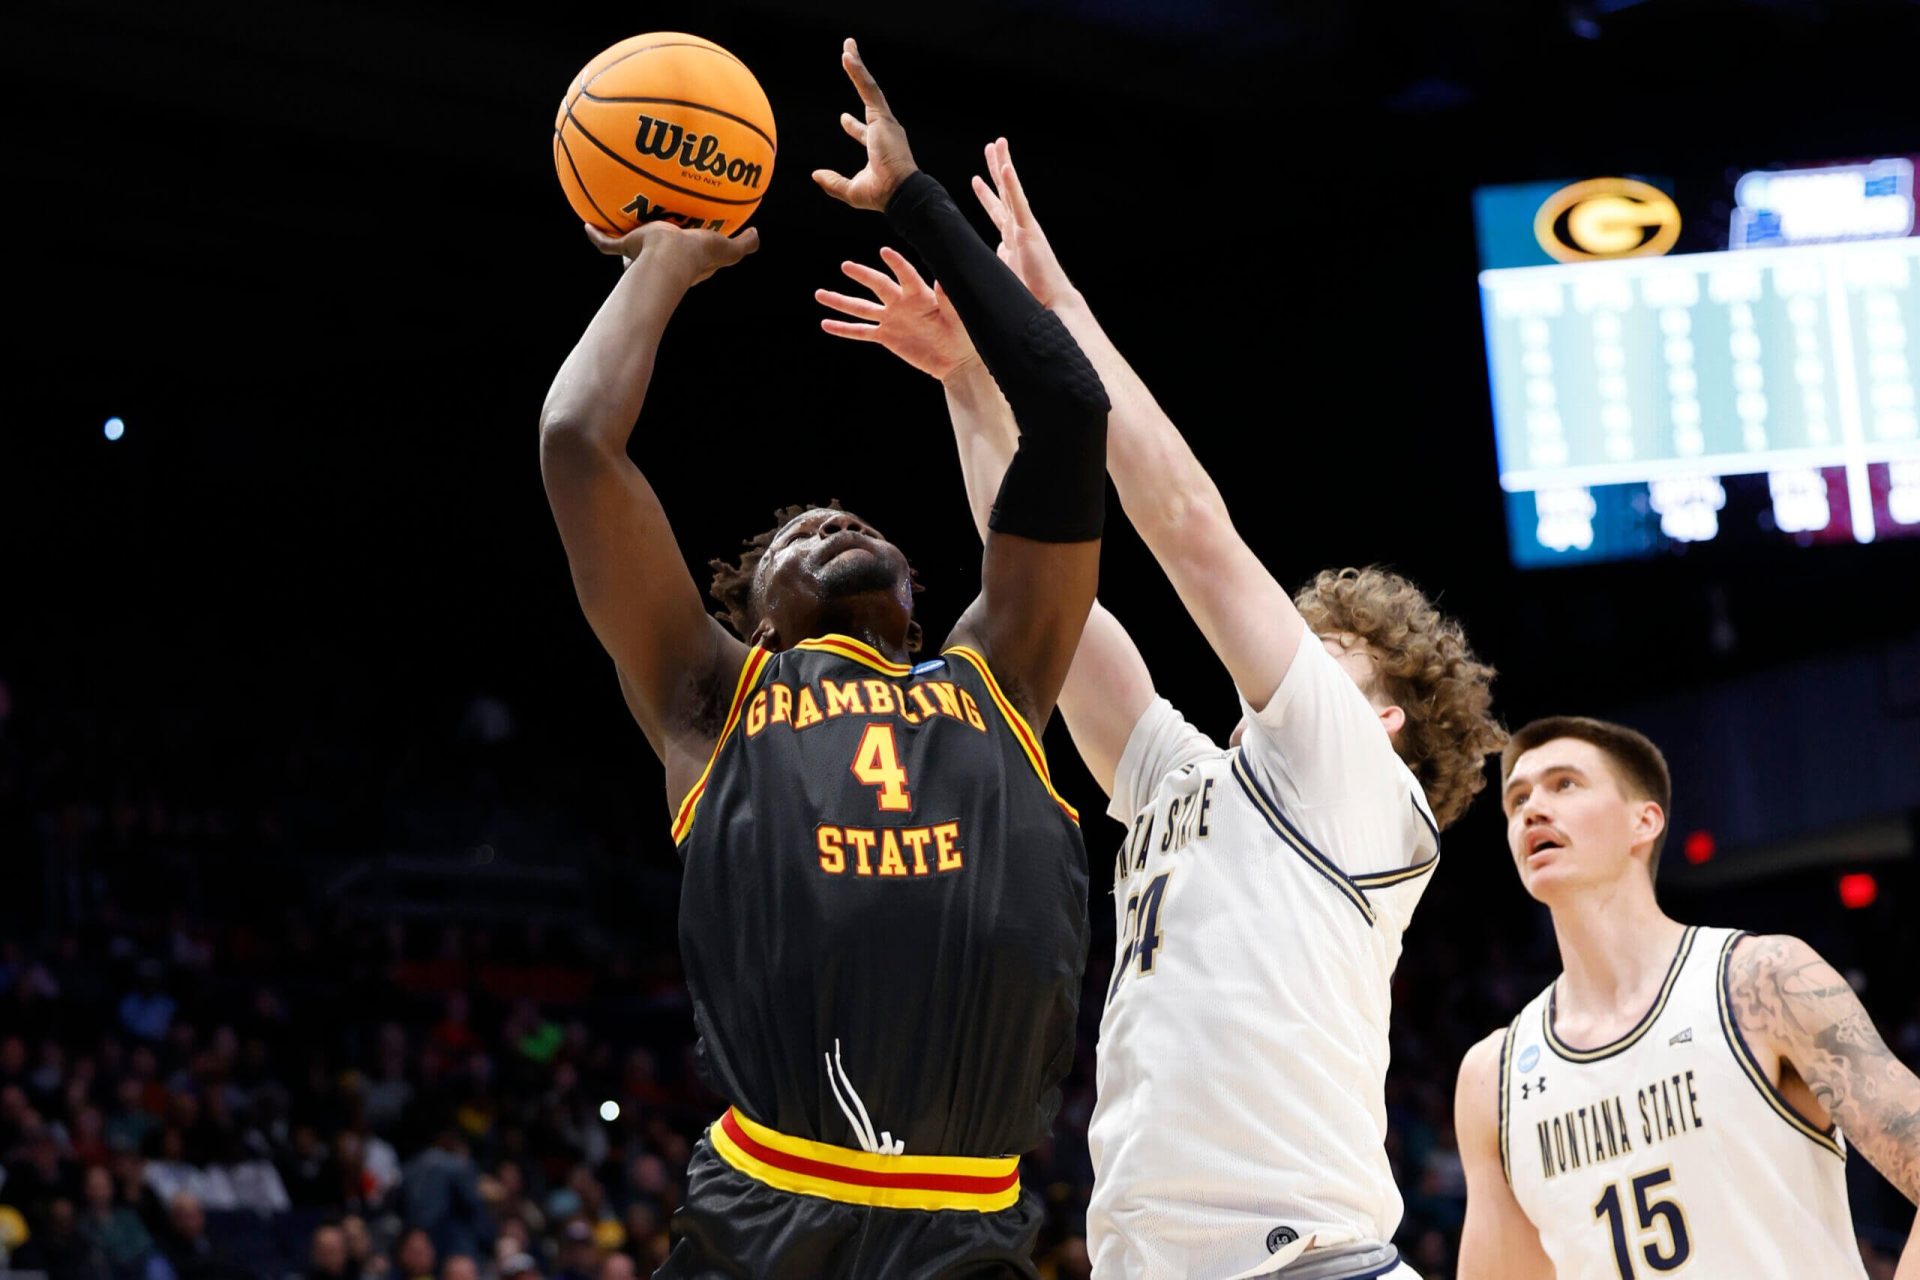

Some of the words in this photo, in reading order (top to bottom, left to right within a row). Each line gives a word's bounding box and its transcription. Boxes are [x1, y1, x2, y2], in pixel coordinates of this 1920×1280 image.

[634, 114, 763, 189] Wilson
[746, 678, 988, 739] GRAMBLING
[851, 722, 912, 812] 4
[816, 820, 963, 877] STATE
[1537, 1095, 1632, 1179] MONTANA
[1638, 1070, 1703, 1145] STATE
[1592, 1164, 1692, 1280] 15
